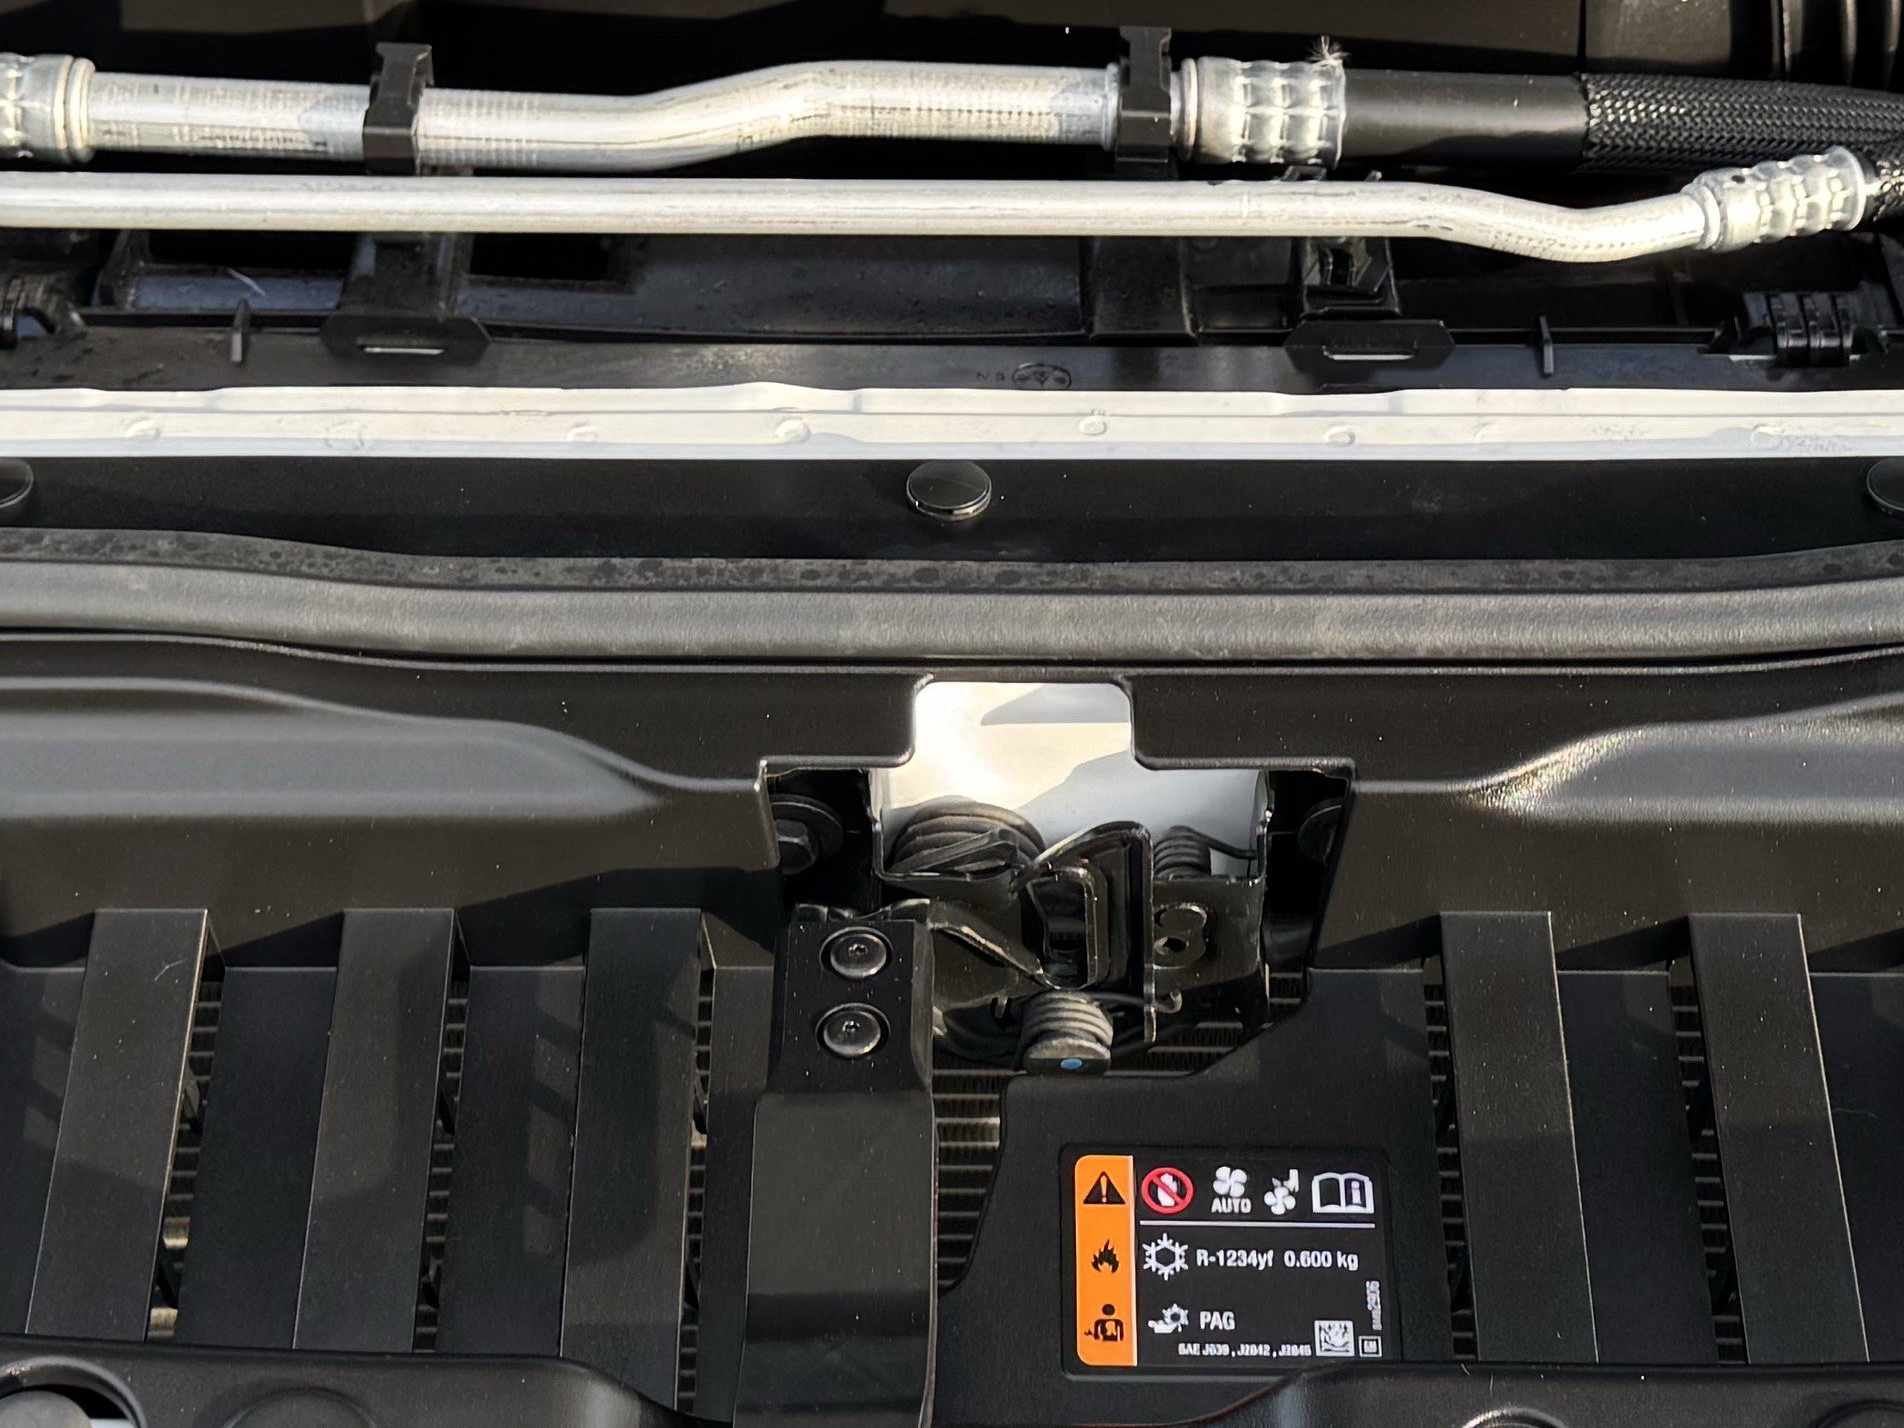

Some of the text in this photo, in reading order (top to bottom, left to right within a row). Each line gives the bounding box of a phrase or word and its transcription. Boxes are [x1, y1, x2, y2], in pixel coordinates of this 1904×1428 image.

[1211, 1197, 1252, 1214] AUTO
[1196, 1249, 1359, 1271] R-1234yf 0.600 kg
[1199, 1311, 1236, 1331] PAG
